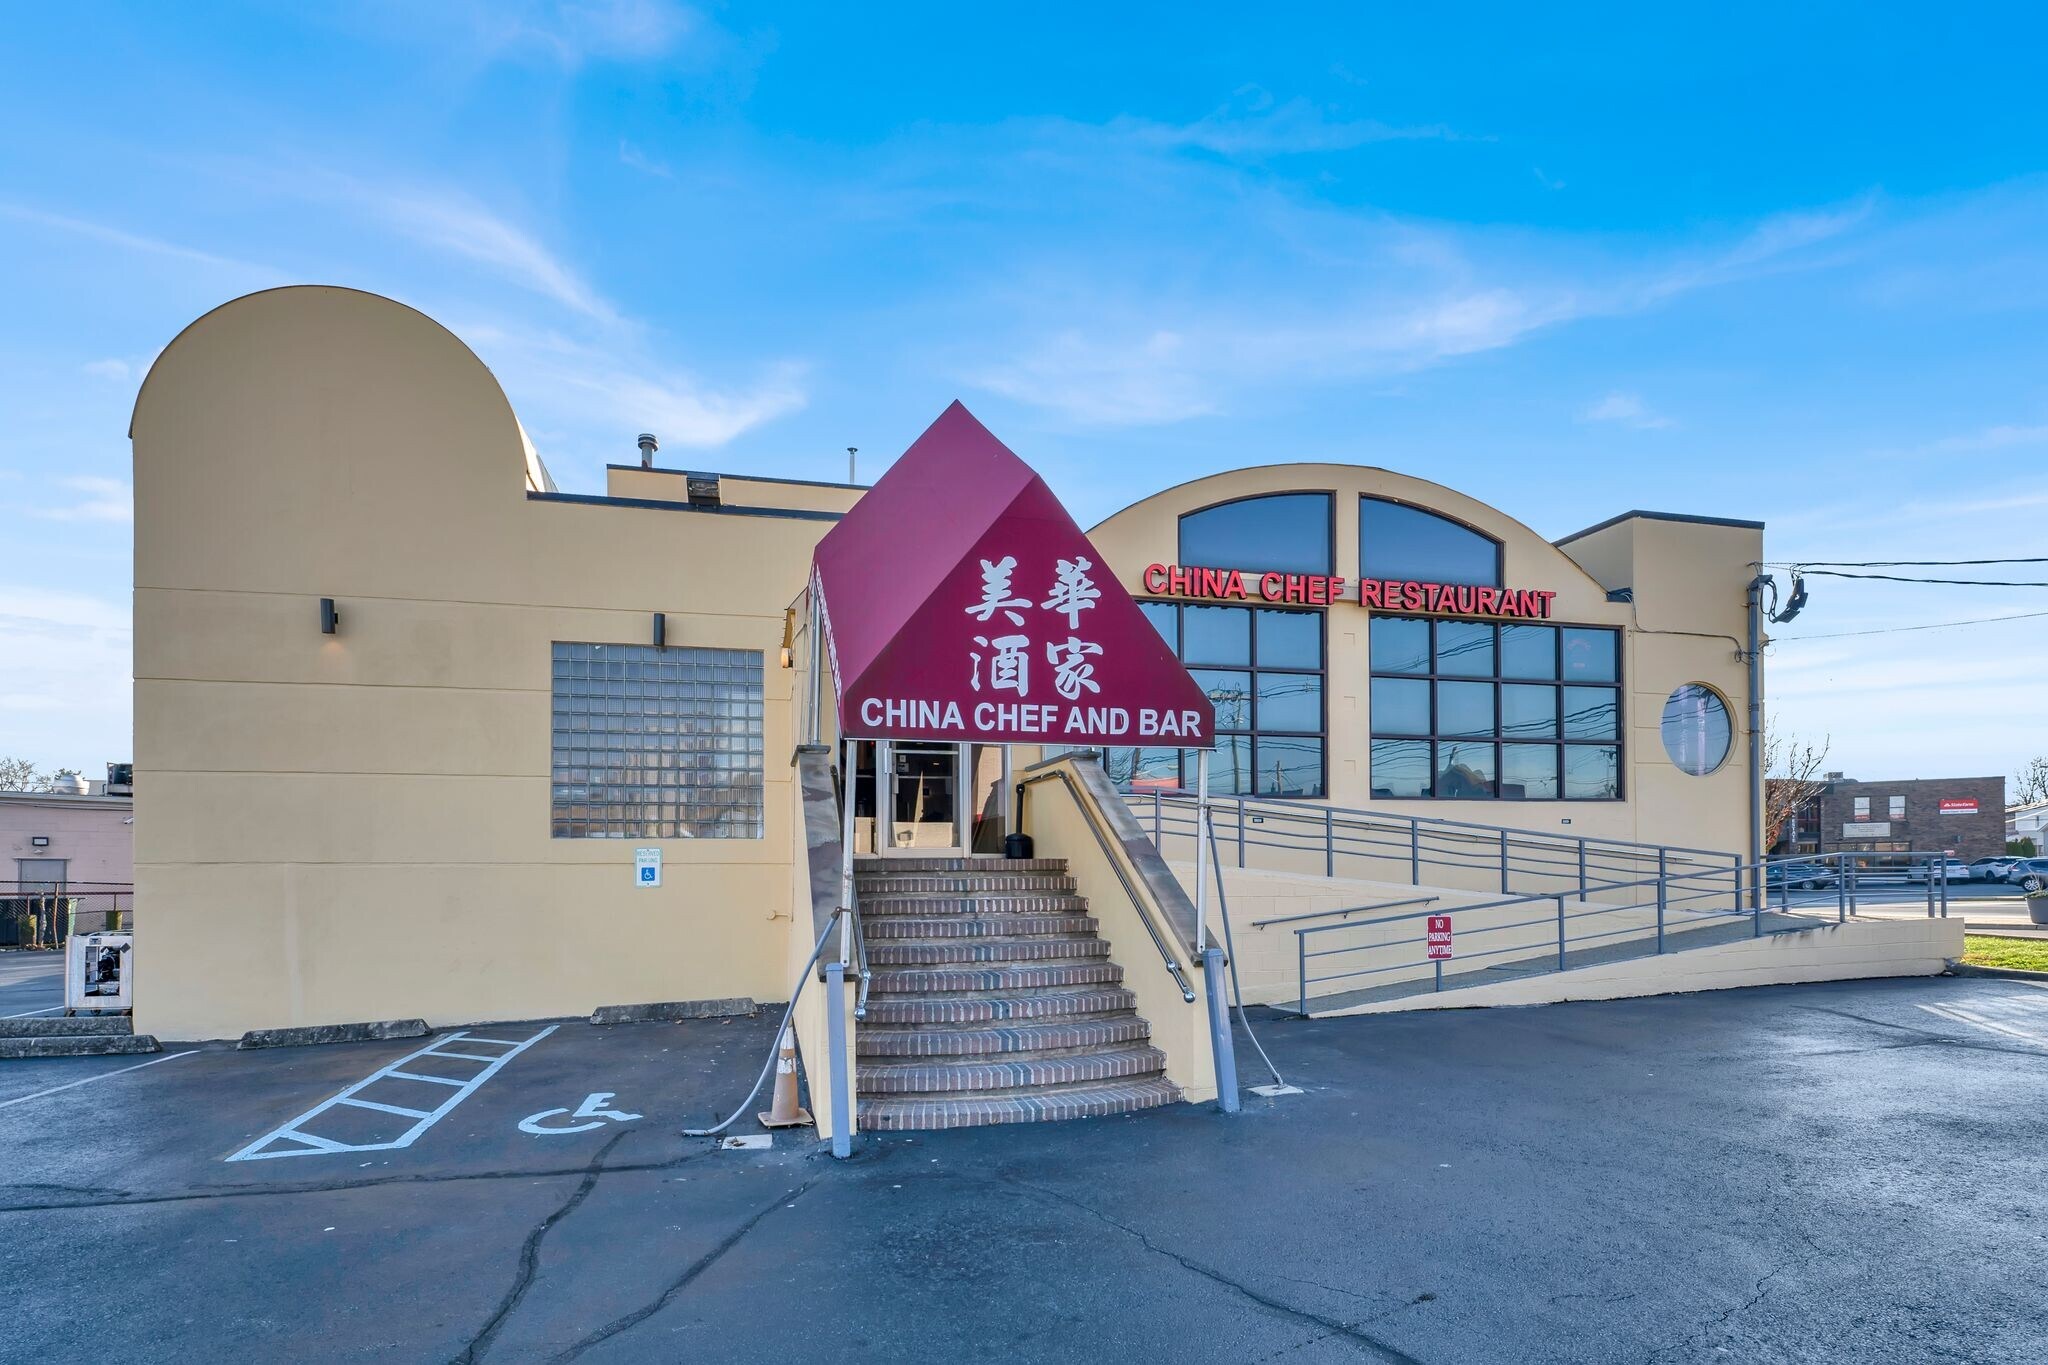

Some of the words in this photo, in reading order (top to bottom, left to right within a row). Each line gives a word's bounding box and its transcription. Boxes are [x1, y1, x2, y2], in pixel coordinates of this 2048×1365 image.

[965, 556, 1101, 629] 美華
[1143, 563, 1247, 600] CHINA
[1259, 571, 1345, 605] CHEF
[1358, 577, 1556, 618] RESTAURANT
[970, 634, 1103, 700] 酒家
[861, 697, 965, 730] CHINA
[974, 702, 1058, 733] CHEF
[1064, 706, 1130, 735] AND
[1140, 708, 1202, 737] BAR
[1428, 932, 1451, 942] PARKING
[1435, 919, 1444, 929] NO
[1428, 944, 1452, 955] ANYTIME
